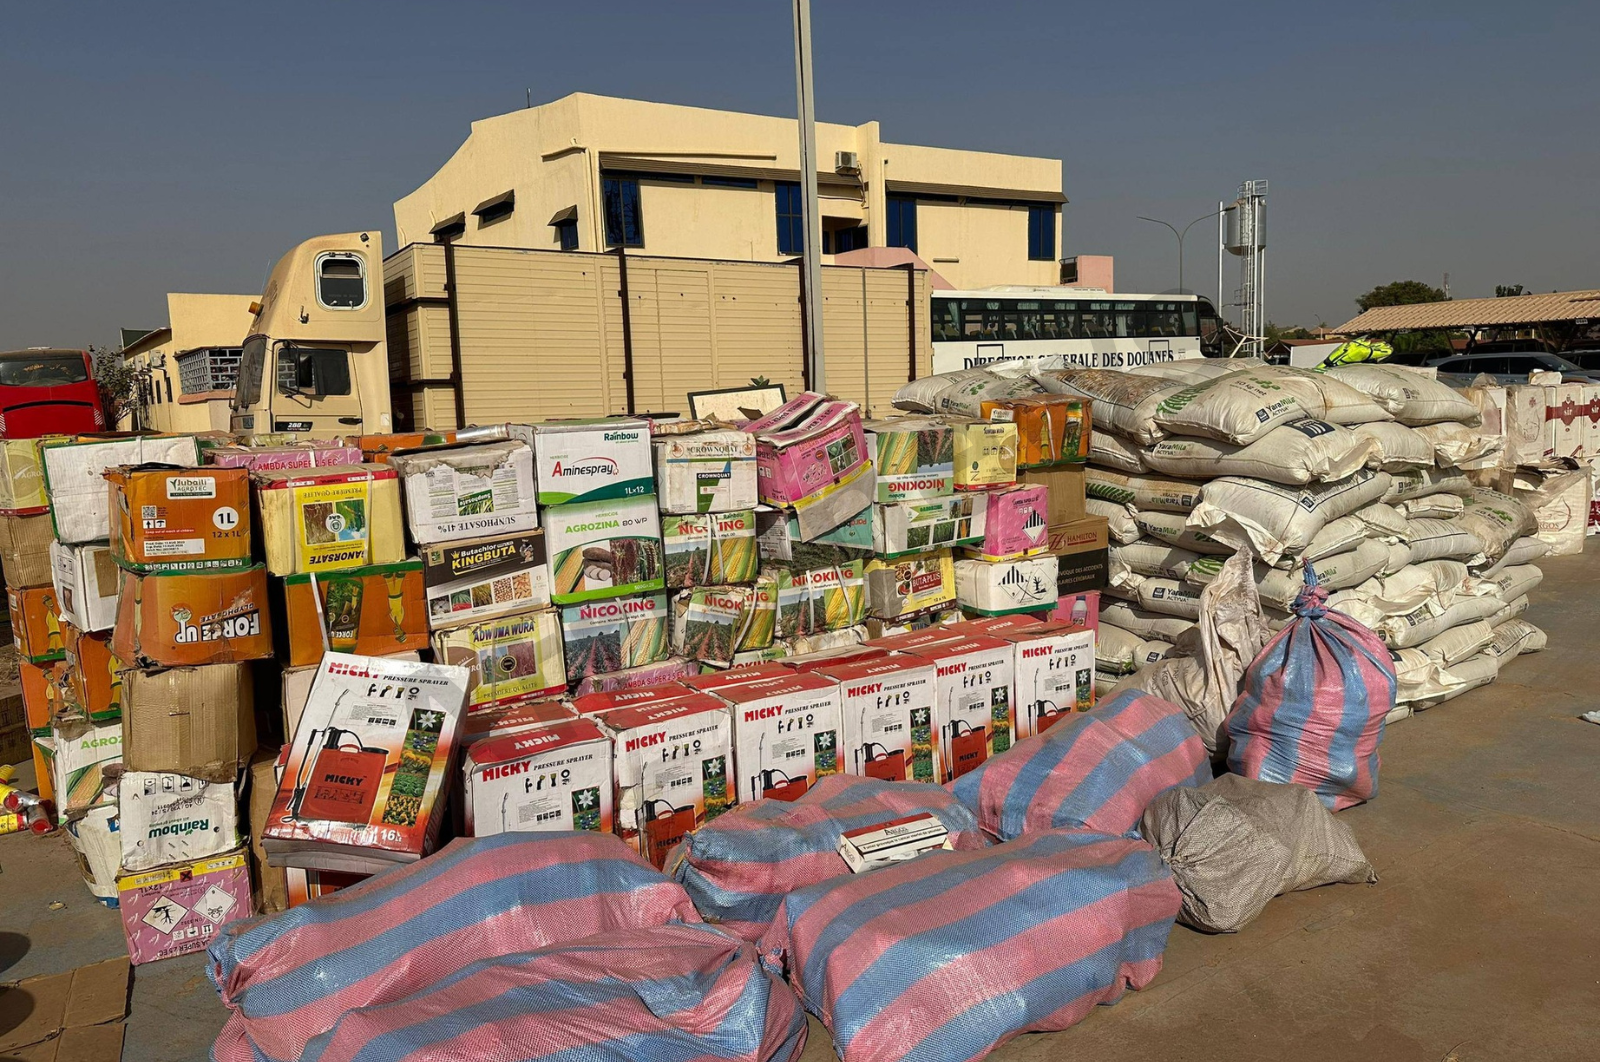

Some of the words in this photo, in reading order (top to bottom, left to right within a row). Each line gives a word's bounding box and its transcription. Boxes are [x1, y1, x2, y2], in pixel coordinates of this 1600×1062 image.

[1102, 351, 1124, 368] DES
[1126, 349, 1174, 367] DOUANES
[1564, 406, 1573, 416] sir
[1591, 404, 1600, 414] sir
[604, 431, 639, 441] Rainbow
[1158, 443, 1187, 451] YaraMila
[252, 461, 287, 471] LAMBDA
[552, 461, 613, 477] Aminespray
[697, 472, 731, 480] CROWNQUAT
[888, 479, 945, 492] NICOKING
[218, 512, 235, 524] 1L
[595, 511, 619, 519] HERBICIDE
[437, 524, 456, 533] 41%
[457, 516, 516, 530] SUNPHOSATE
[565, 519, 620, 534] AGROZINA
[622, 519, 633, 527] 80
[634, 517, 648, 526] WP
[1538, 521, 1559, 530] RGOS
[212, 531, 222, 539] 12
[1067, 531, 1097, 543] HAMILTON
[460, 544, 497, 557] Butachlor
[452, 545, 516, 570] KINGBUTA
[1317, 568, 1337, 581] araMila
[580, 599, 656, 620] NICOKING
[175, 619, 198, 643] UP
[202, 610, 261, 642] FORCE
[511, 621, 535, 635] WURA
[950, 642, 980, 652] MICKY
[1022, 645, 1053, 659] MICKY
[937, 661, 967, 677] MICKY
[382, 674, 418, 684] PRESSURE
[418, 677, 449, 686] SPRAYER
[622, 678, 647, 689] AMBDA
[647, 674, 667, 685] SUPER
[614, 691, 655, 701] MICKY
[848, 682, 882, 698] MICKY
[647, 706, 688, 720] MICKY
[744, 705, 784, 722] MICKY
[784, 704, 810, 715] PRESSURE
[810, 701, 831, 711] SPRAYER
[81, 735, 123, 750] AGROZ
[514, 733, 561, 750] MICKY
[625, 731, 667, 752] MICKY
[668, 730, 695, 742] PRESSURE
[696, 724, 719, 736] SPRAYER
[959, 751, 979, 762] MICKY
[482, 760, 532, 782] MICKY
[533, 758, 566, 771] PRESSURE
[566, 753, 594, 765] SPRAYER
[324, 774, 364, 786] MICKY
[148, 819, 209, 840] Rainbow
[656, 835, 683, 848] MICKY
[179, 940, 201, 952] SUPER
